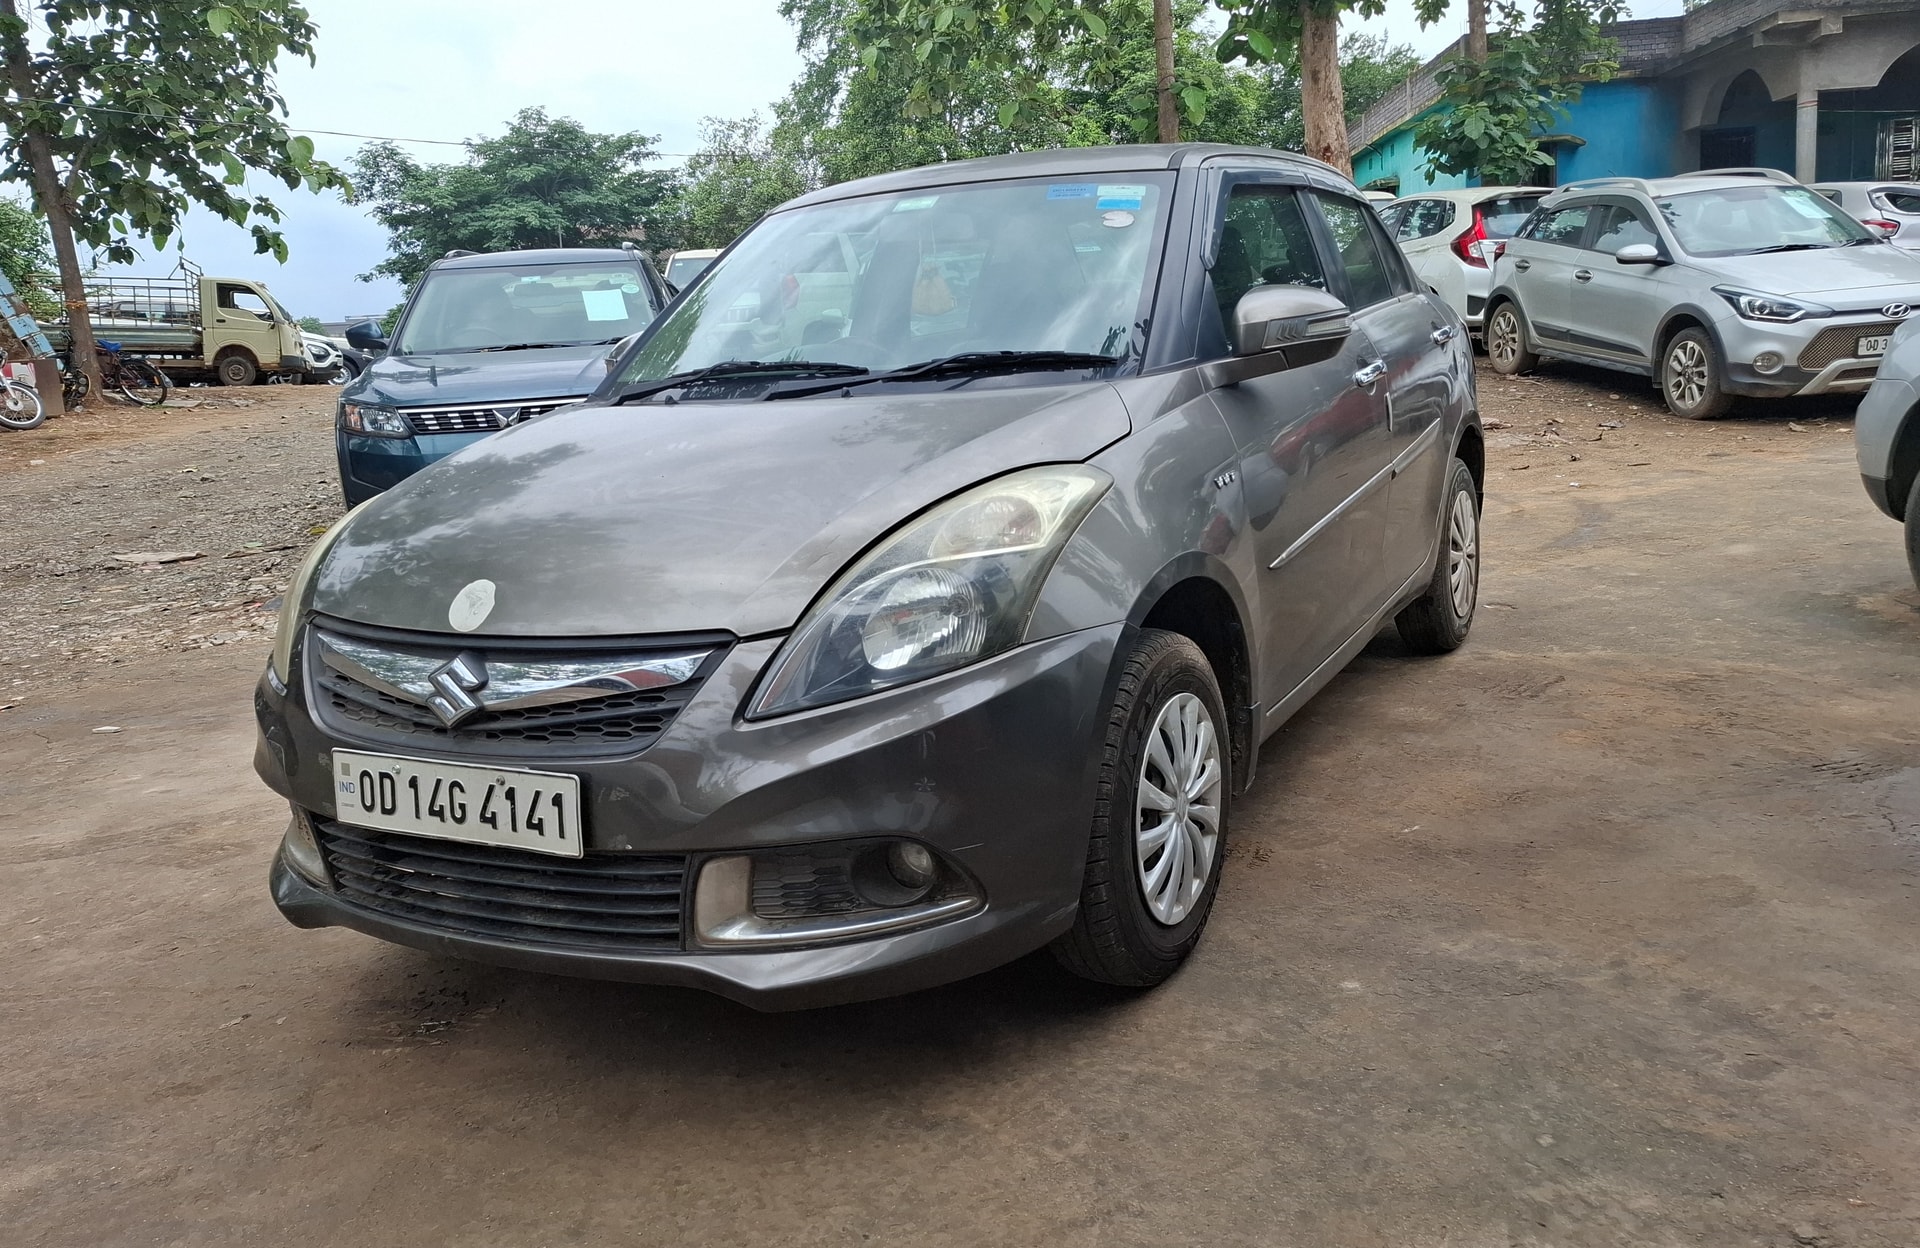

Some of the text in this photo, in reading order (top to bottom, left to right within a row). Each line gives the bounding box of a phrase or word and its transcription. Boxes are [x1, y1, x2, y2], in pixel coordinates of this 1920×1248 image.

[1866, 339, 1879, 351] OD
[338, 780, 356, 794] IND
[359, 769, 565, 839] OD 14G 4141
